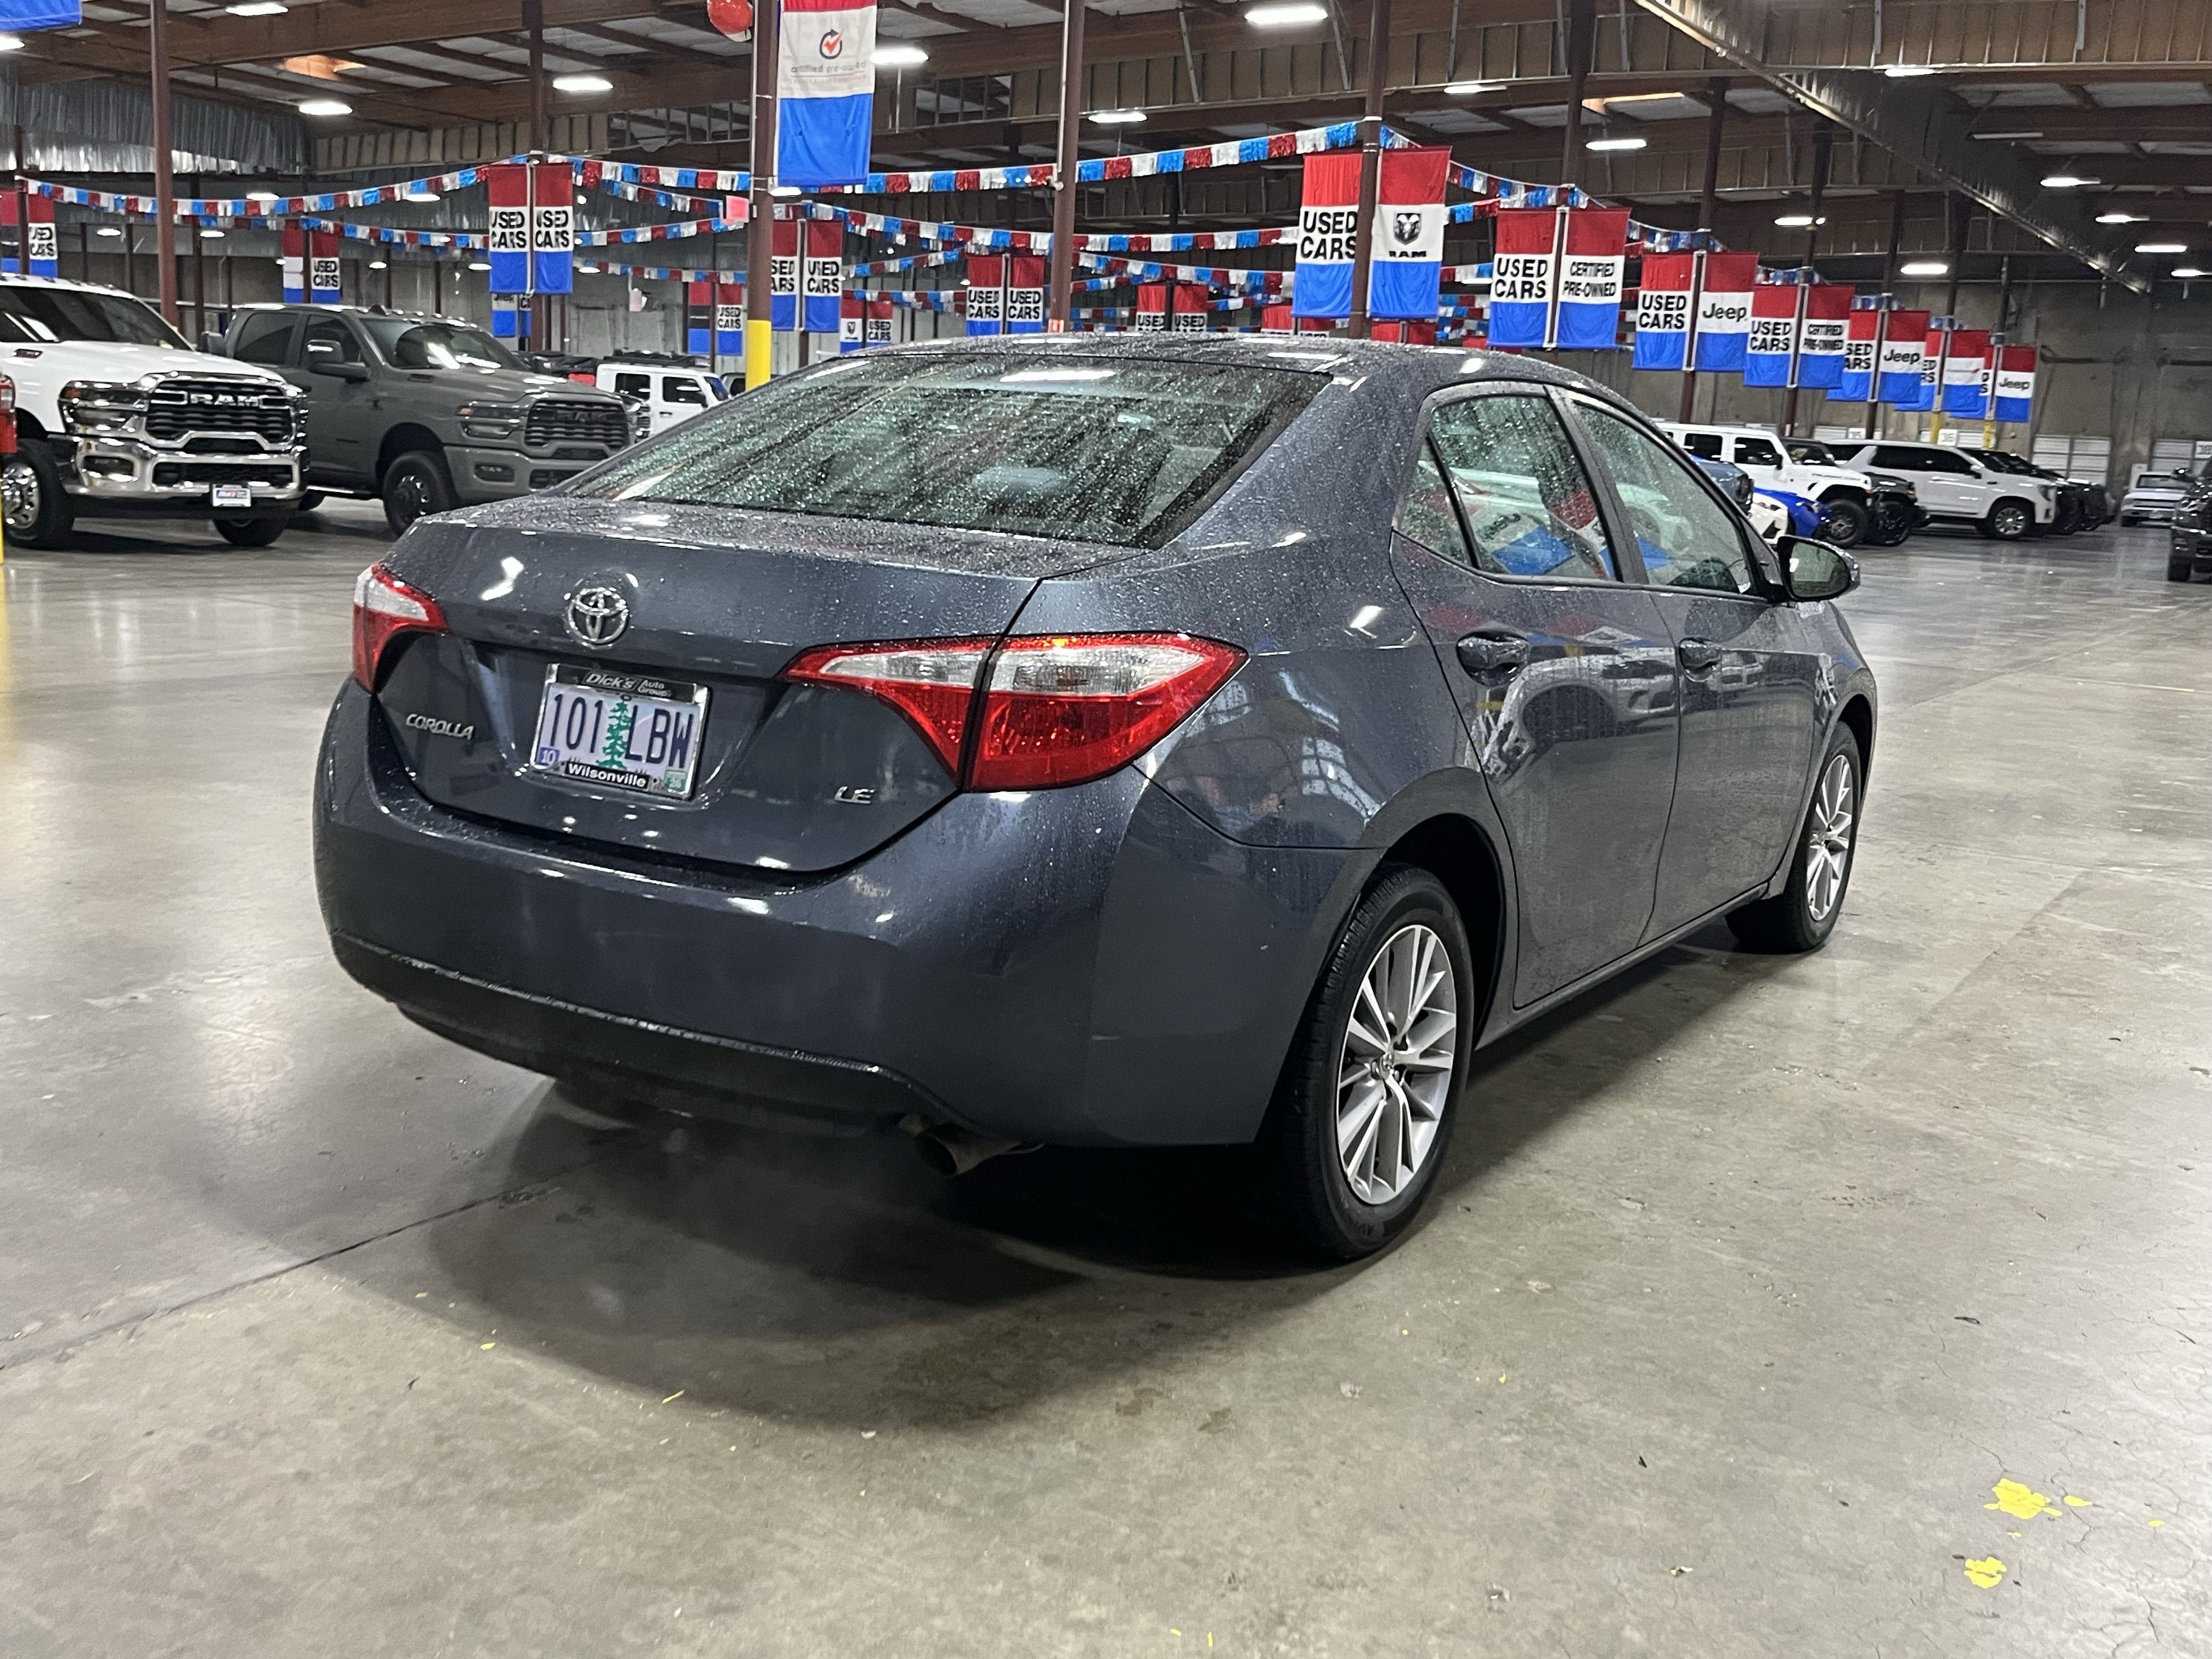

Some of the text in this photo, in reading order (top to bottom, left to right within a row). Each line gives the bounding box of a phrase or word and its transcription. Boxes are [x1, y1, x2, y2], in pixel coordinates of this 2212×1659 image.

[490, 211, 525, 229] USED
[536, 210, 568, 228] USED
[1304, 211, 1357, 234] USED
[535, 230, 569, 248] CARS
[30, 242, 54, 257] CAS
[1300, 236, 1356, 260] CARS
[314, 260, 337, 273] USED
[771, 259, 795, 275] SED
[1497, 258, 1548, 278] USED
[313, 274, 338, 287] CRS
[771, 277, 794, 292] ARS
[1494, 279, 1546, 298] CARS
[968, 290, 1000, 304] USED
[1010, 290, 1041, 304] USED
[1642, 294, 1686, 311] USED
[967, 304, 1000, 319] CARS
[1008, 305, 1040, 319] CARS
[1702, 303, 1747, 323] Jeep
[1138, 314, 1164, 327] USED
[1175, 315, 1205, 327] USED
[1639, 312, 1685, 329] CARS
[1752, 321, 1792, 336] USED
[1750, 336, 1790, 351] CARS
[1846, 343, 1873, 356] SED
[1844, 357, 1871, 370] ARS
[1884, 349, 1920, 365] Jeep
[1999, 377, 2030, 391] Jeep
[190, 393, 259, 407] RAM
[586, 673, 635, 689] Dick's
[640, 680, 665, 689] Auto
[405, 713, 475, 740] COROLLA
[550, 693, 695, 769] 101 LBW
[567, 763, 647, 789] Wilsonville
[834, 786, 876, 804] LE
